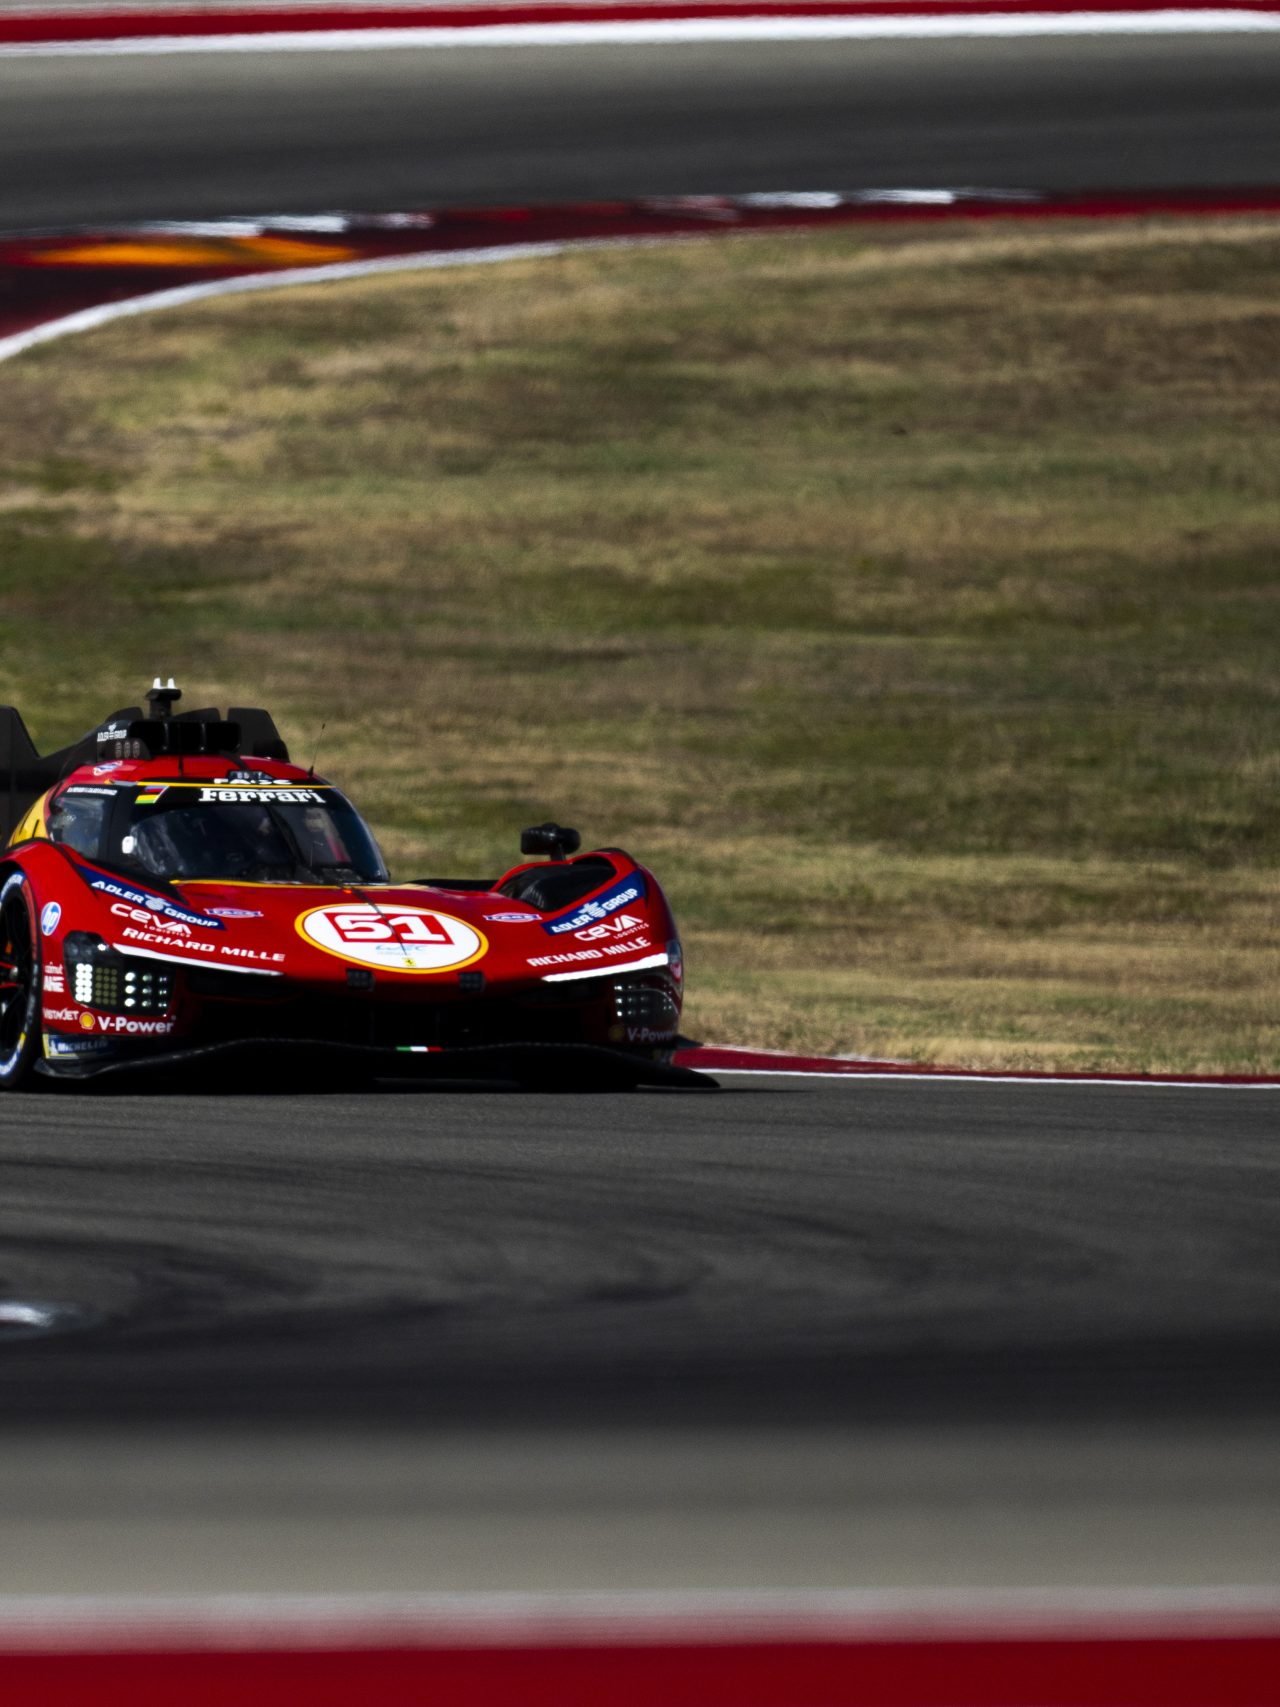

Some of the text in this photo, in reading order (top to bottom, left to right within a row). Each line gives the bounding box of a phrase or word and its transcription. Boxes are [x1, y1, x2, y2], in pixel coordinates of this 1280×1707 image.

[199, 787, 327, 804] Ferrari
[91, 880, 145, 904] ADLER
[164, 907, 219, 927] GROUP
[550, 914, 594, 933] ADLER
[602, 888, 638, 910] GROUP
[144, 924, 191, 938] LOGISTICS
[330, 913, 447, 941] 51
[122, 927, 287, 962] RICHARD MILLE
[526, 936, 652, 967] RICHARD MILLE
[97, 1015, 174, 1033] V-Power
